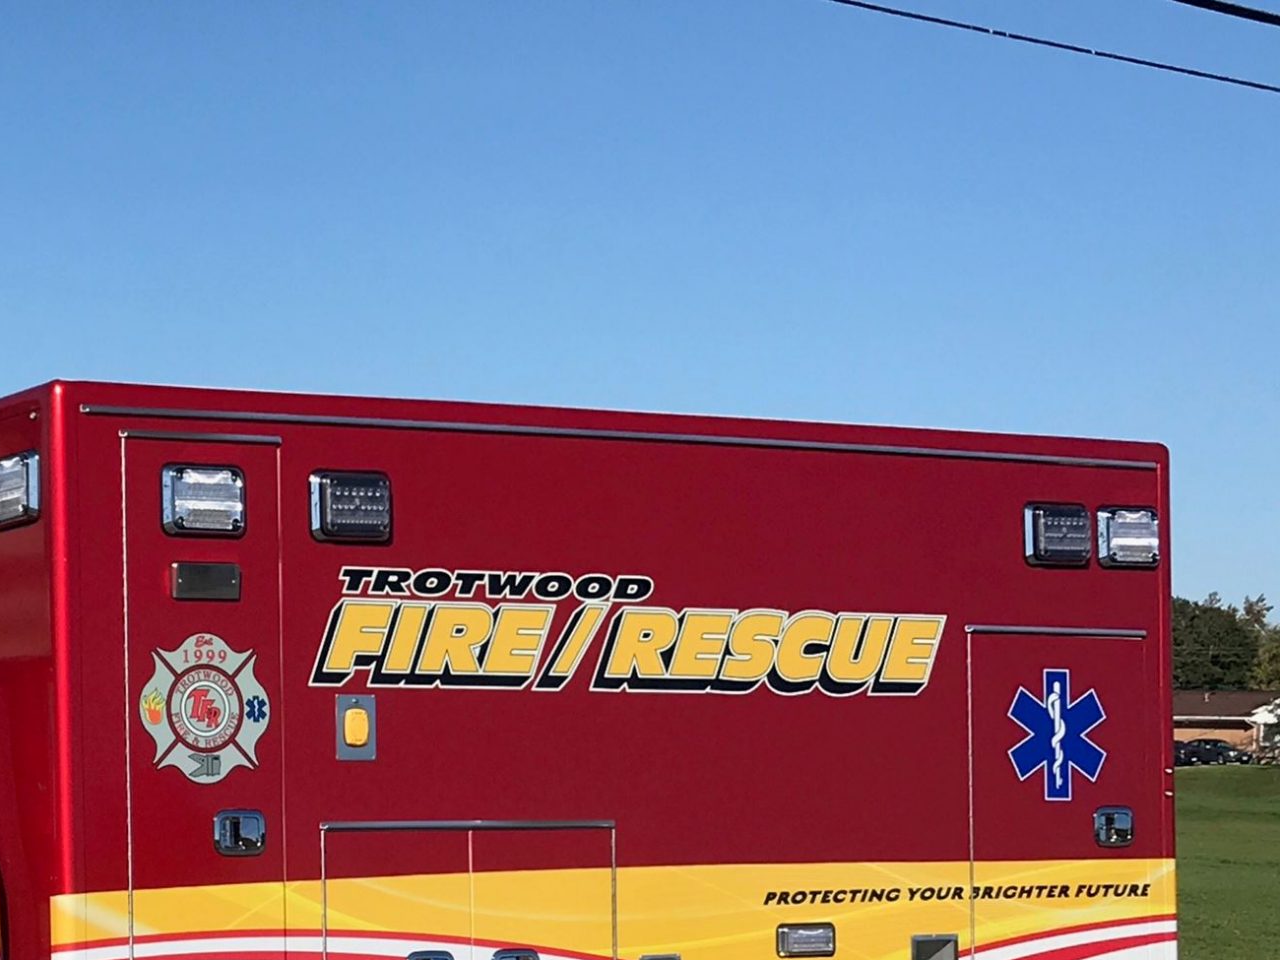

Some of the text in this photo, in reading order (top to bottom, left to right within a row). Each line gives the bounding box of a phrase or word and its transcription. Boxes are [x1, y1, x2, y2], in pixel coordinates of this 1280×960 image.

[340, 567, 653, 601] TROTWOOD
[183, 649, 227, 663] 1999
[308, 598, 947, 696] FIRE/RESCUE
[175, 670, 235, 697] TROTWOOD
[187, 688, 222, 728] TFR
[172, 711, 190, 738] FIRE
[205, 711, 238, 748] RESCUE
[763, 883, 1151, 906] PROTECTING YOUR BRIGHTER FUTURE
